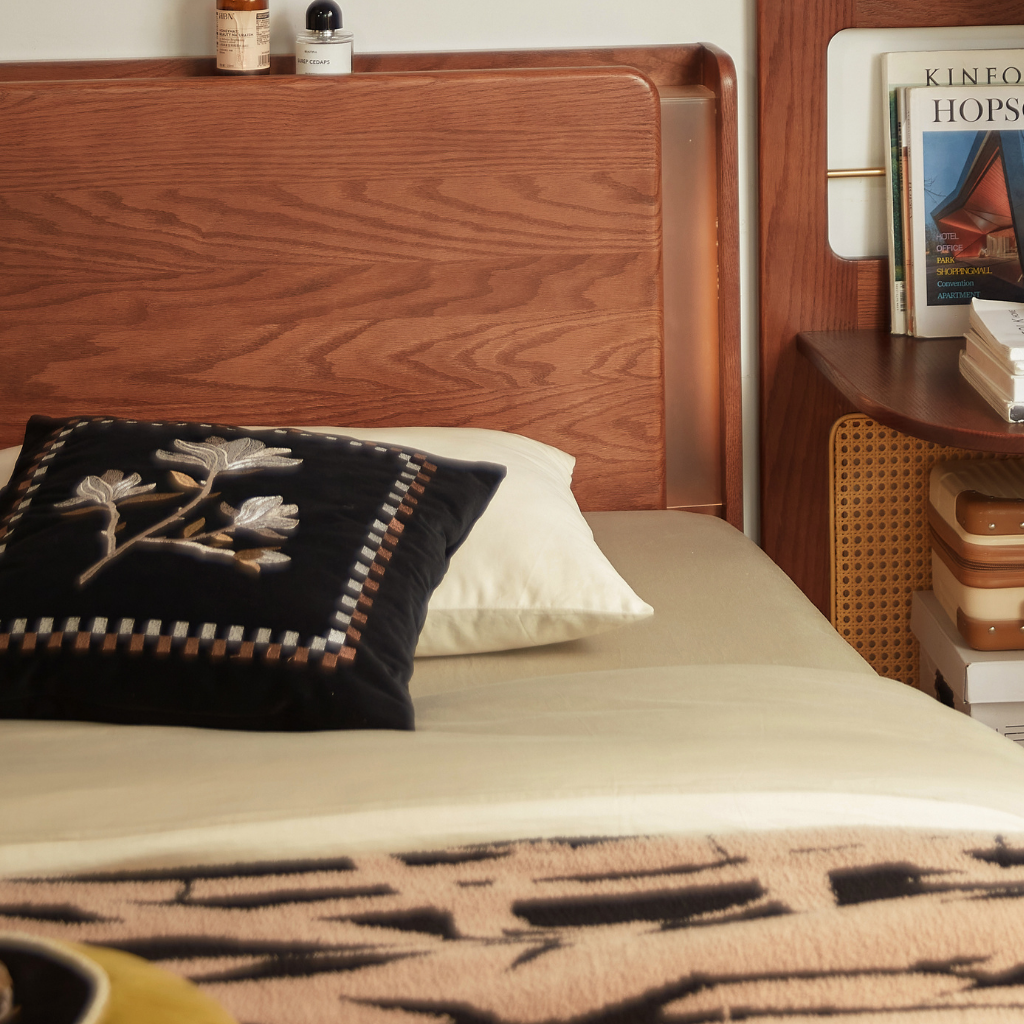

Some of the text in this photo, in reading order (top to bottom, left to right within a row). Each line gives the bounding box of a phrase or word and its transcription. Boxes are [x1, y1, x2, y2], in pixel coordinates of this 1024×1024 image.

[936, 232, 959, 240] HOTEL
[936, 244, 964, 252] OFFICE
[936, 267, 993, 276] SHOPPINGMALL
[937, 280, 975, 288] Convention
[937, 291, 981, 300] APARTMENT
